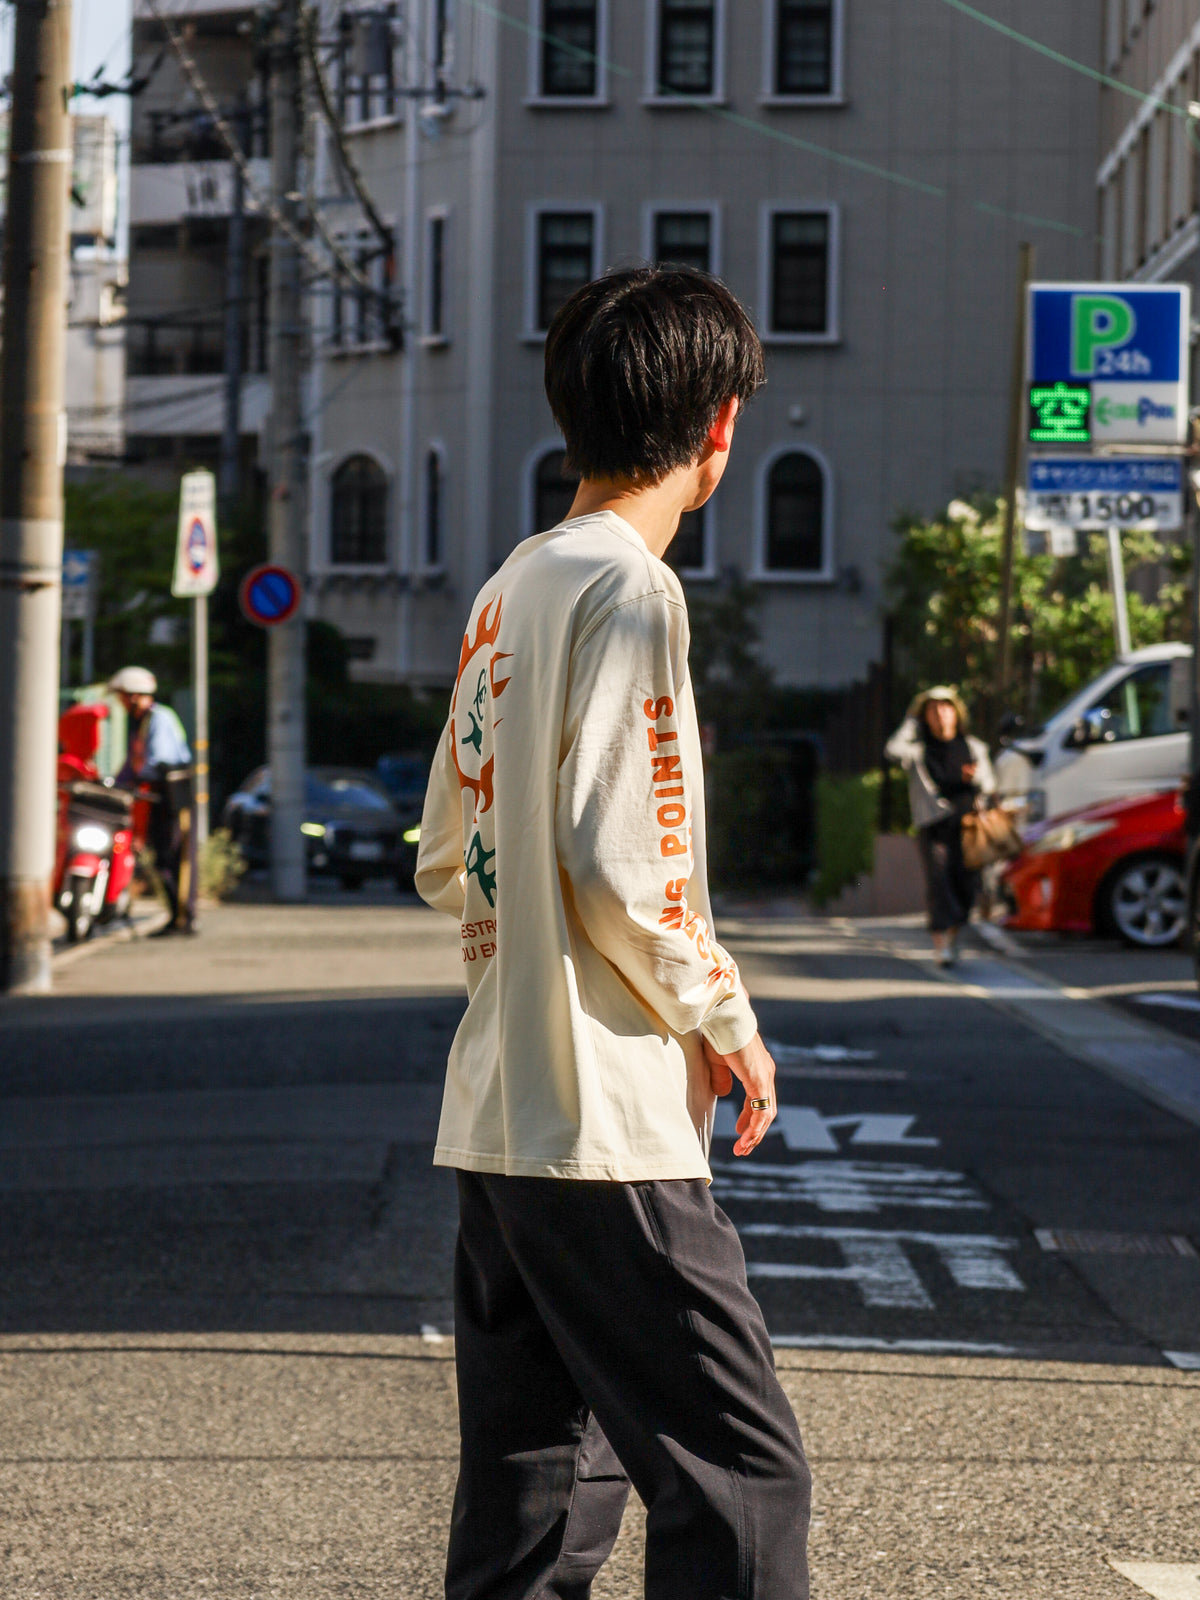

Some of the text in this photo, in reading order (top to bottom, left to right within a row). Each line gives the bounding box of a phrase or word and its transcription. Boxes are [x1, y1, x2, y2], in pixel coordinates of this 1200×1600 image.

[1071, 294, 1134, 376] P
[1100, 348, 1151, 375] 24h
[1030, 382, 1091, 442] 空
[643, 695, 688, 858] POINTS
[461, 919, 497, 939] ESTR
[462, 946, 477, 962] U
